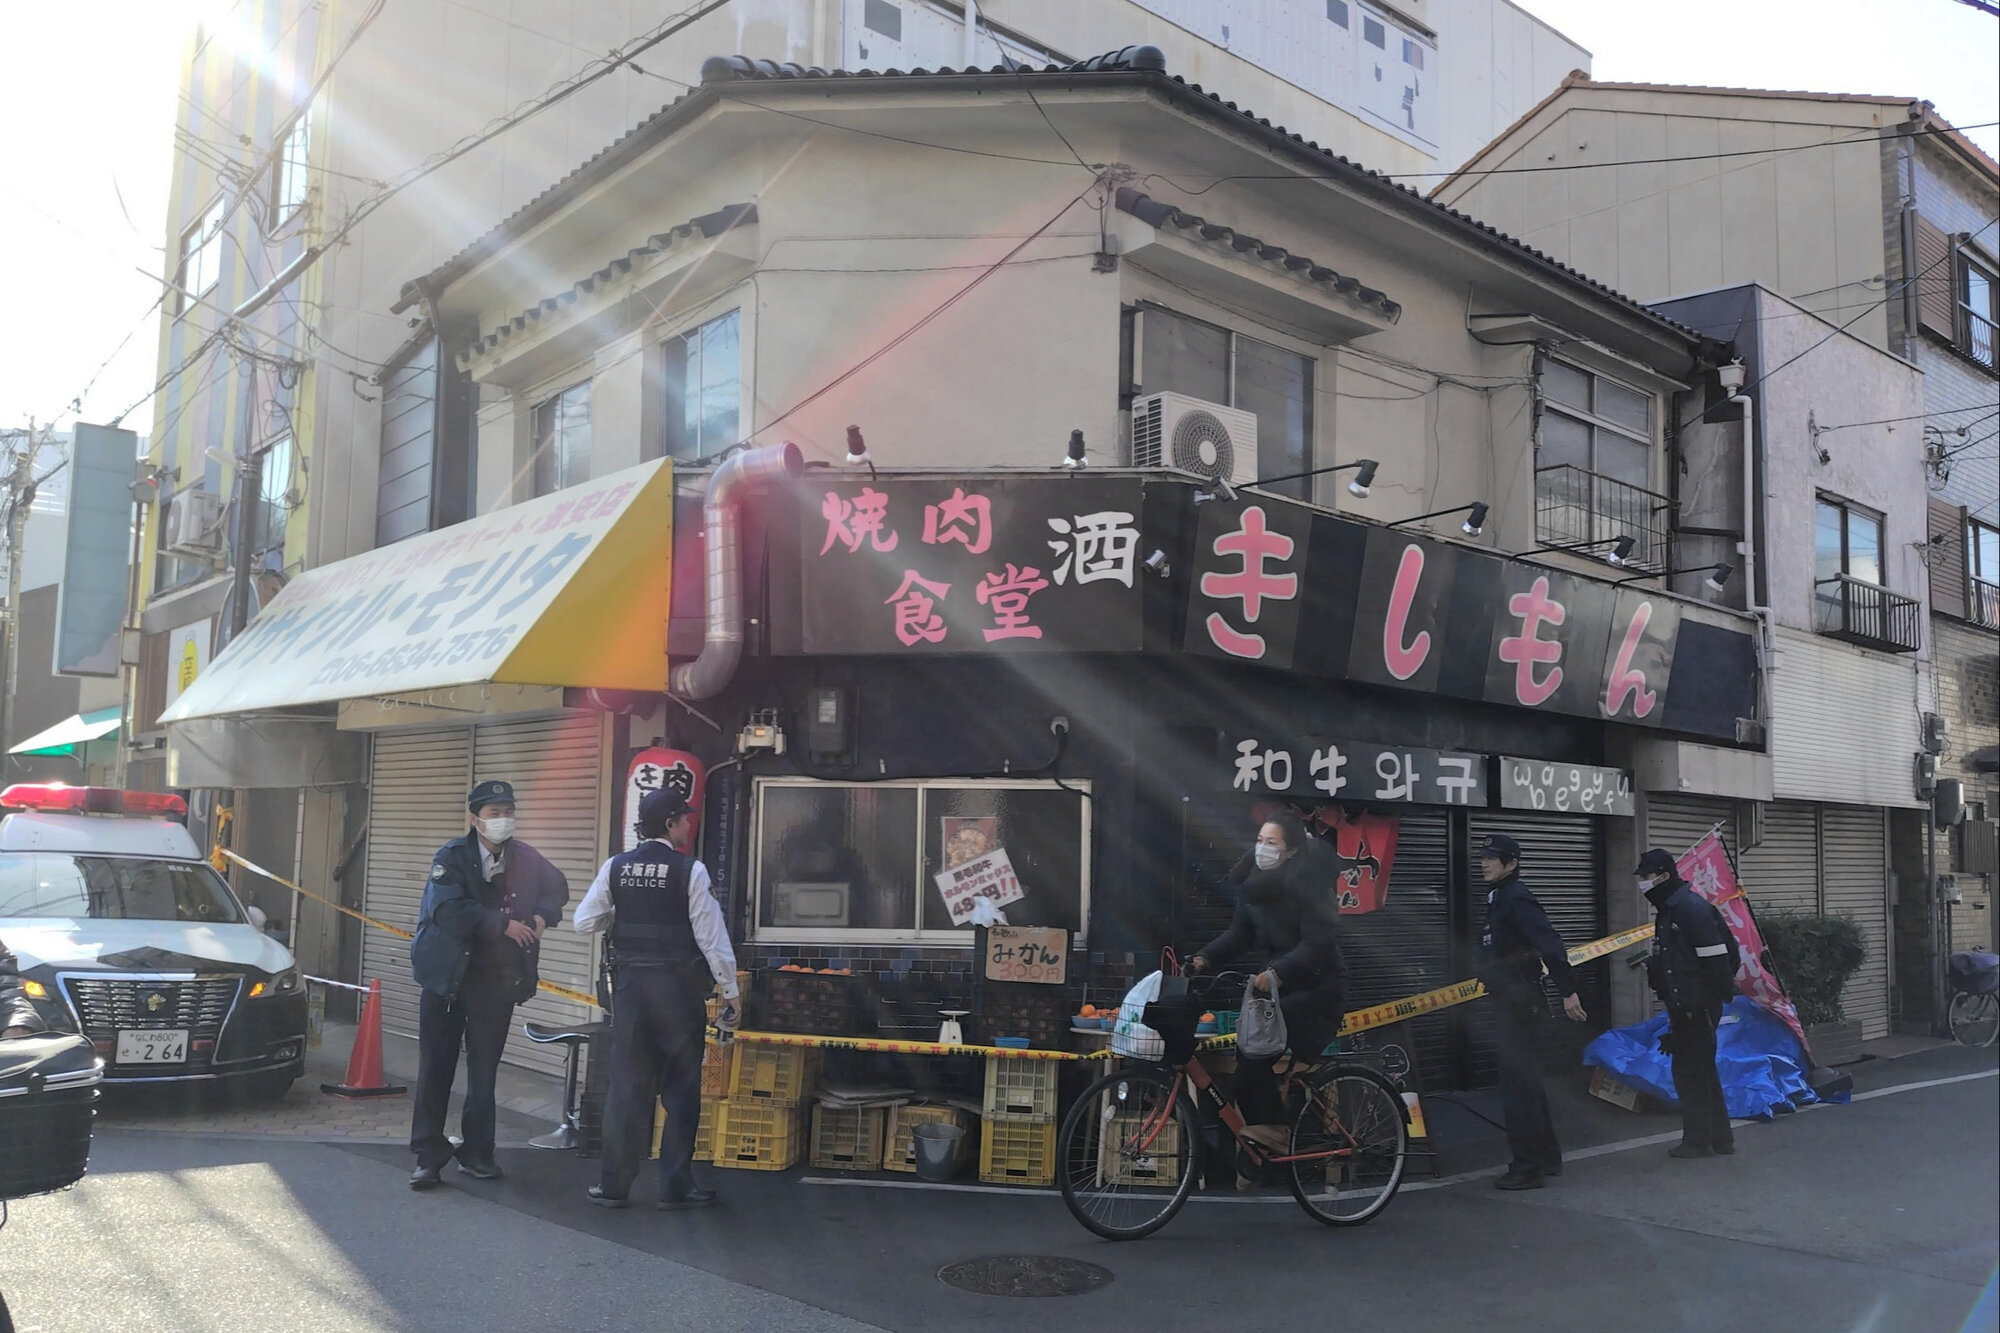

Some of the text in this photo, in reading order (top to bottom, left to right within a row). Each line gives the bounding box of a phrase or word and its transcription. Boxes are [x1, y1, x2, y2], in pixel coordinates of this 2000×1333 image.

[820, 487, 993, 556] 焼肉
[1047, 511, 1141, 589] 酒
[884, 562, 1049, 647] 食堂
[1200, 505, 1657, 719] きしもん
[1374, 751, 1477, 804] 와규
[1513, 766, 1630, 799] wagyu
[1529, 784, 1615, 814] beef
[620, 862, 669, 879] 大阪府警
[620, 878, 667, 888] POLICE
[717, 868, 725, 881] 5
[992, 943, 1060, 966] みかん
[998, 961, 1061, 981] 300円
